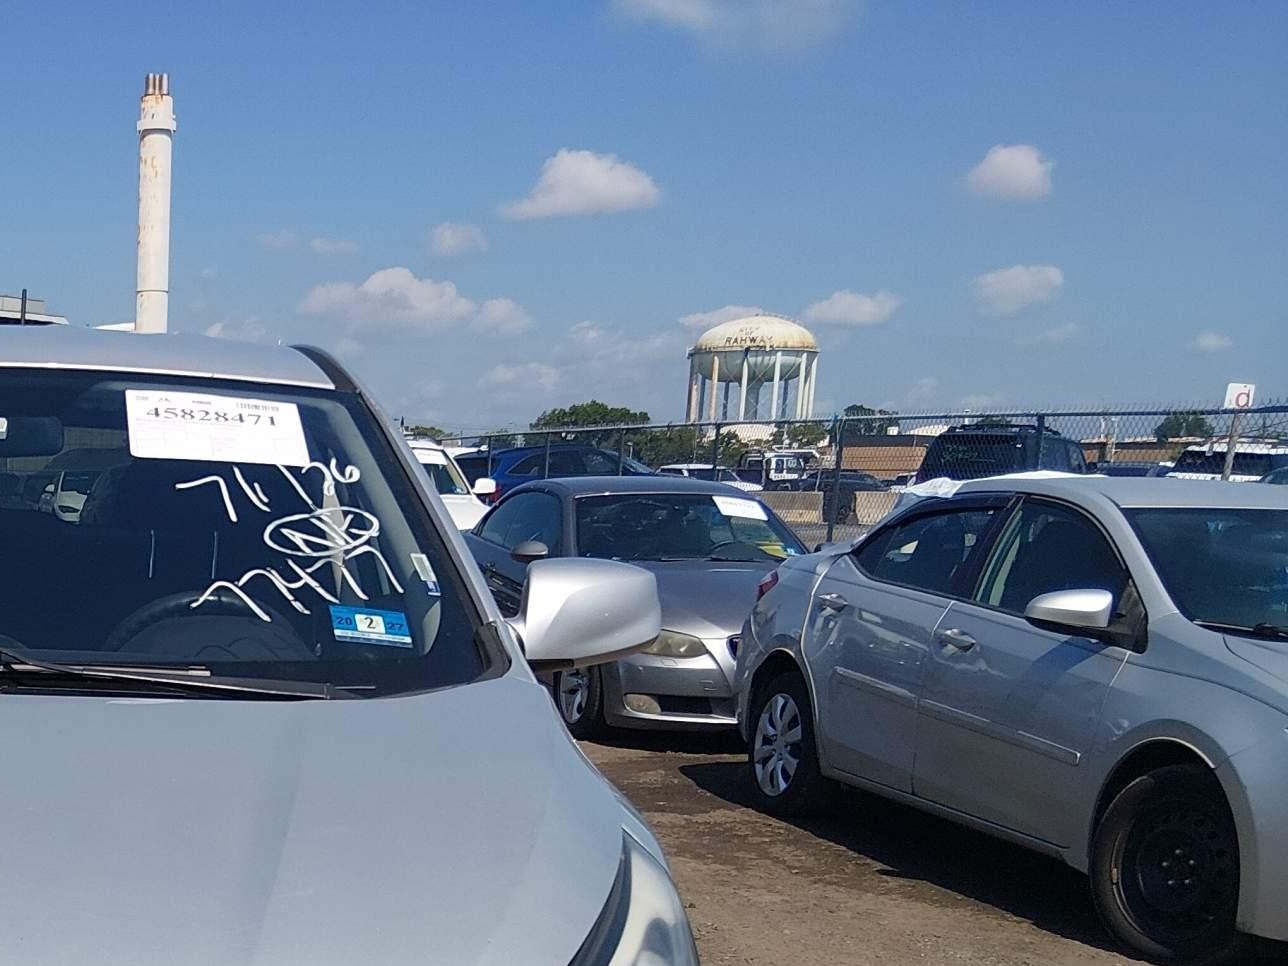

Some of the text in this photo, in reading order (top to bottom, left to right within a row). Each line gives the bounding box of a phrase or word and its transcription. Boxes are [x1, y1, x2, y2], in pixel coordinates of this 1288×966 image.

[724, 335, 774, 345] RAHWAY
[146, 407, 276, 426] 45828471
[336, 616, 404, 632] 20 2 27
